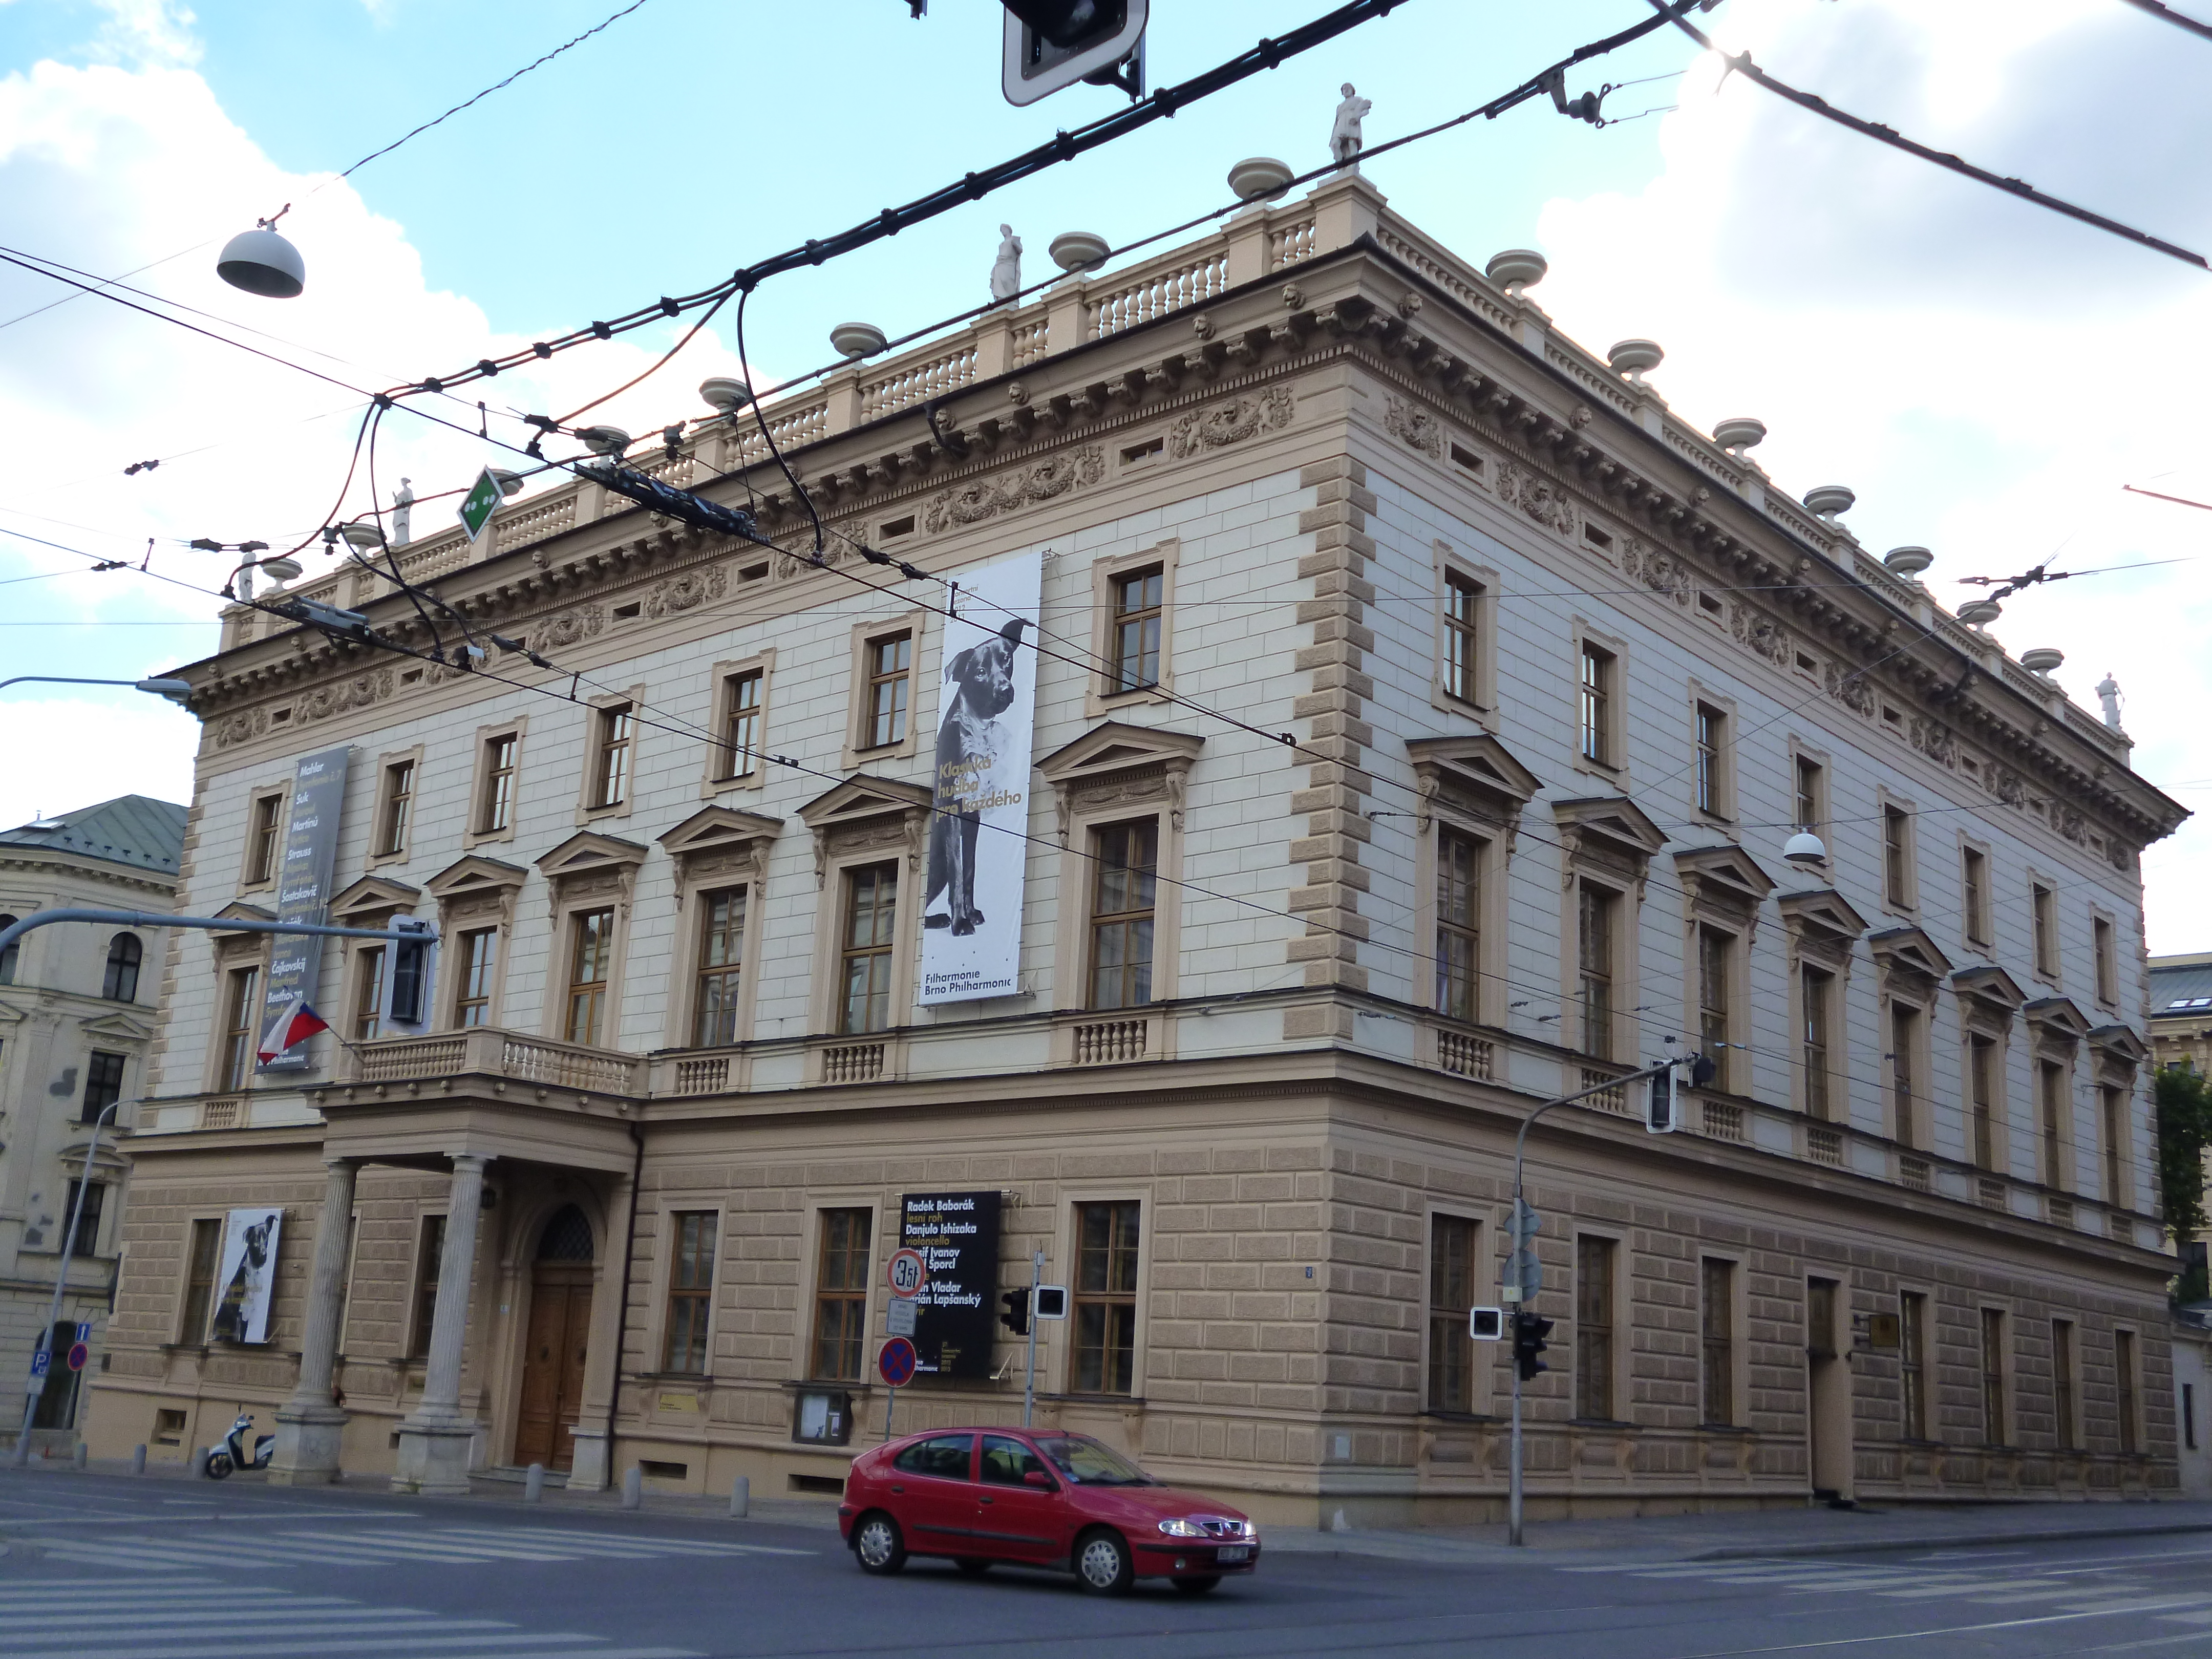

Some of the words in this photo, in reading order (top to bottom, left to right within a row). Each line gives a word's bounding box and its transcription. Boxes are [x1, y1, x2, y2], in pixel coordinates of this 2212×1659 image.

[300, 762, 324, 777] Mahler
[938, 778, 979, 798] hudba
[296, 792, 309, 804] Suk
[936, 804, 958, 823] pro
[962, 789, 1022, 813] každého
[292, 816, 318, 833] Martinů
[288, 848, 312, 860] Strauss
[281, 885, 317, 903] Šostakovič
[272, 958, 306, 976] Čajkovskij
[926, 971, 980, 984] Filharmonie
[925, 986, 946, 995] Brno
[949, 979, 1011, 993] Philharmonic
[907, 1200, 934, 1211] Radek
[937, 1199, 974, 1211] Baborák
[907, 1213, 926, 1223] lesní
[928, 1212, 942, 1222] roh
[906, 1223, 938, 1237] Danjulo
[941, 1222, 977, 1234] Ishizaka
[905, 1235, 950, 1246] violoncello
[930, 1247, 960, 1259] Ivanov
[931, 1282, 961, 1292] Vladar
[934, 1293, 981, 1308] Lapšanský
[35, 1353, 47, 1367] P
